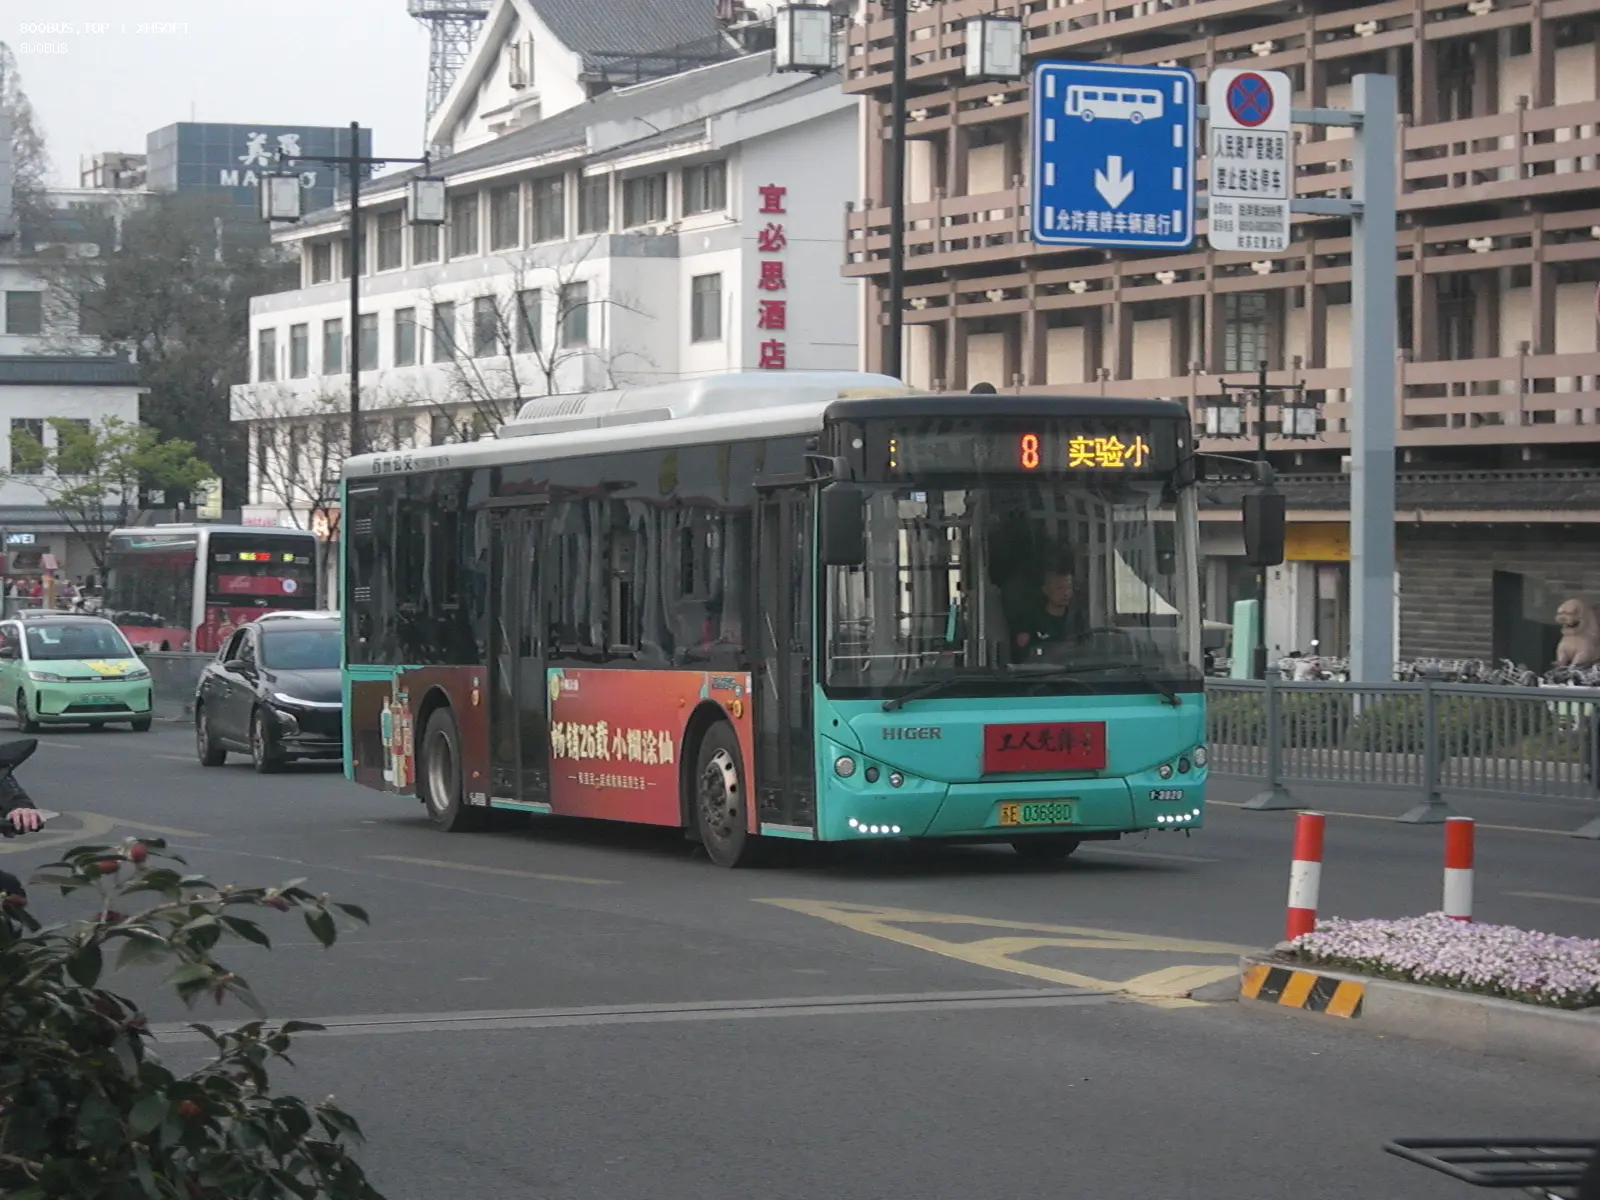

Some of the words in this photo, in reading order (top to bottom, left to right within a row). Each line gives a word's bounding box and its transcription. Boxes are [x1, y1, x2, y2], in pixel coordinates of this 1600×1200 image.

[219, 169, 317, 189] MAO
[1056, 208, 1172, 236] 允许黄牌车辆通行
[757, 183, 788, 370] 宜必思酒店
[1019, 433, 1040, 470] 8
[1068, 434, 1150, 469] 实验小
[550, 719, 611, 761] 畅销26载
[611, 727, 674, 765] 小糊涂仙
[881, 726, 942, 741] HIGER
